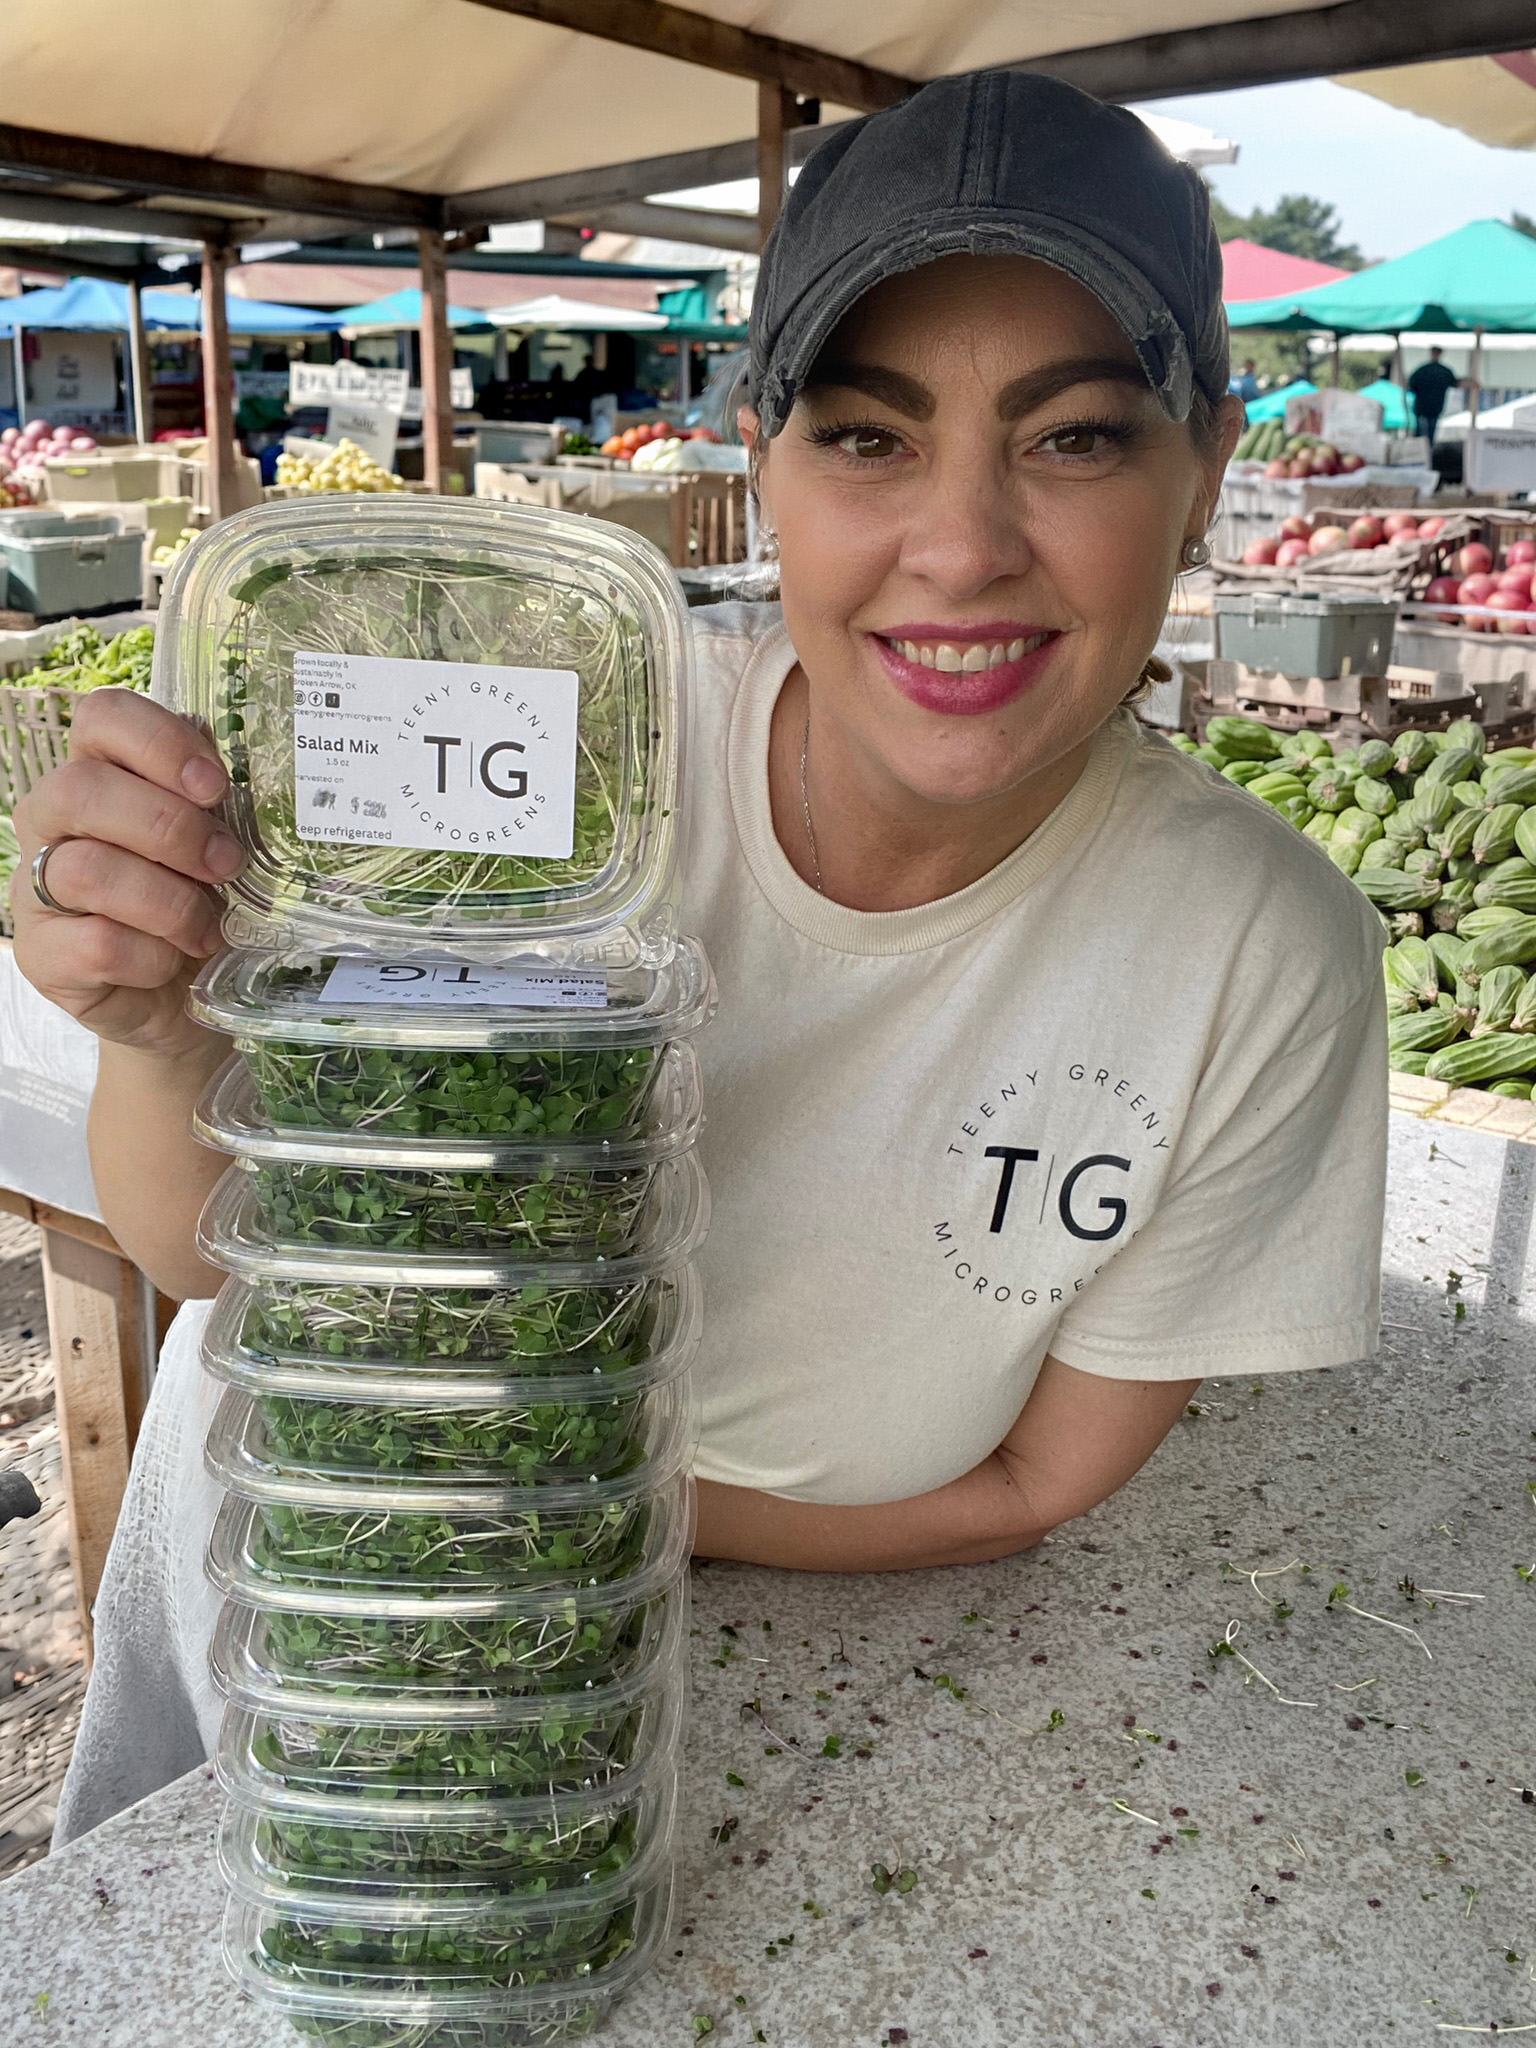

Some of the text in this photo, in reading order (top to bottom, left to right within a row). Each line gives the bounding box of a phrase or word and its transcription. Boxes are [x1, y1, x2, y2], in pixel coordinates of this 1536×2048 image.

[317, 658, 342, 669] locally
[345, 682, 357, 690] OK
[397, 681, 549, 742] TEENY GREENY
[297, 735, 379, 755] Salad Mix
[326, 757, 339, 766] 1.5
[400, 784, 546, 844] MICROGREENS
[324, 826, 392, 840] refrigerated
[947, 1064, 1170, 1155] TEENY GREENY
[934, 1221, 1138, 1305] MICROGRE
